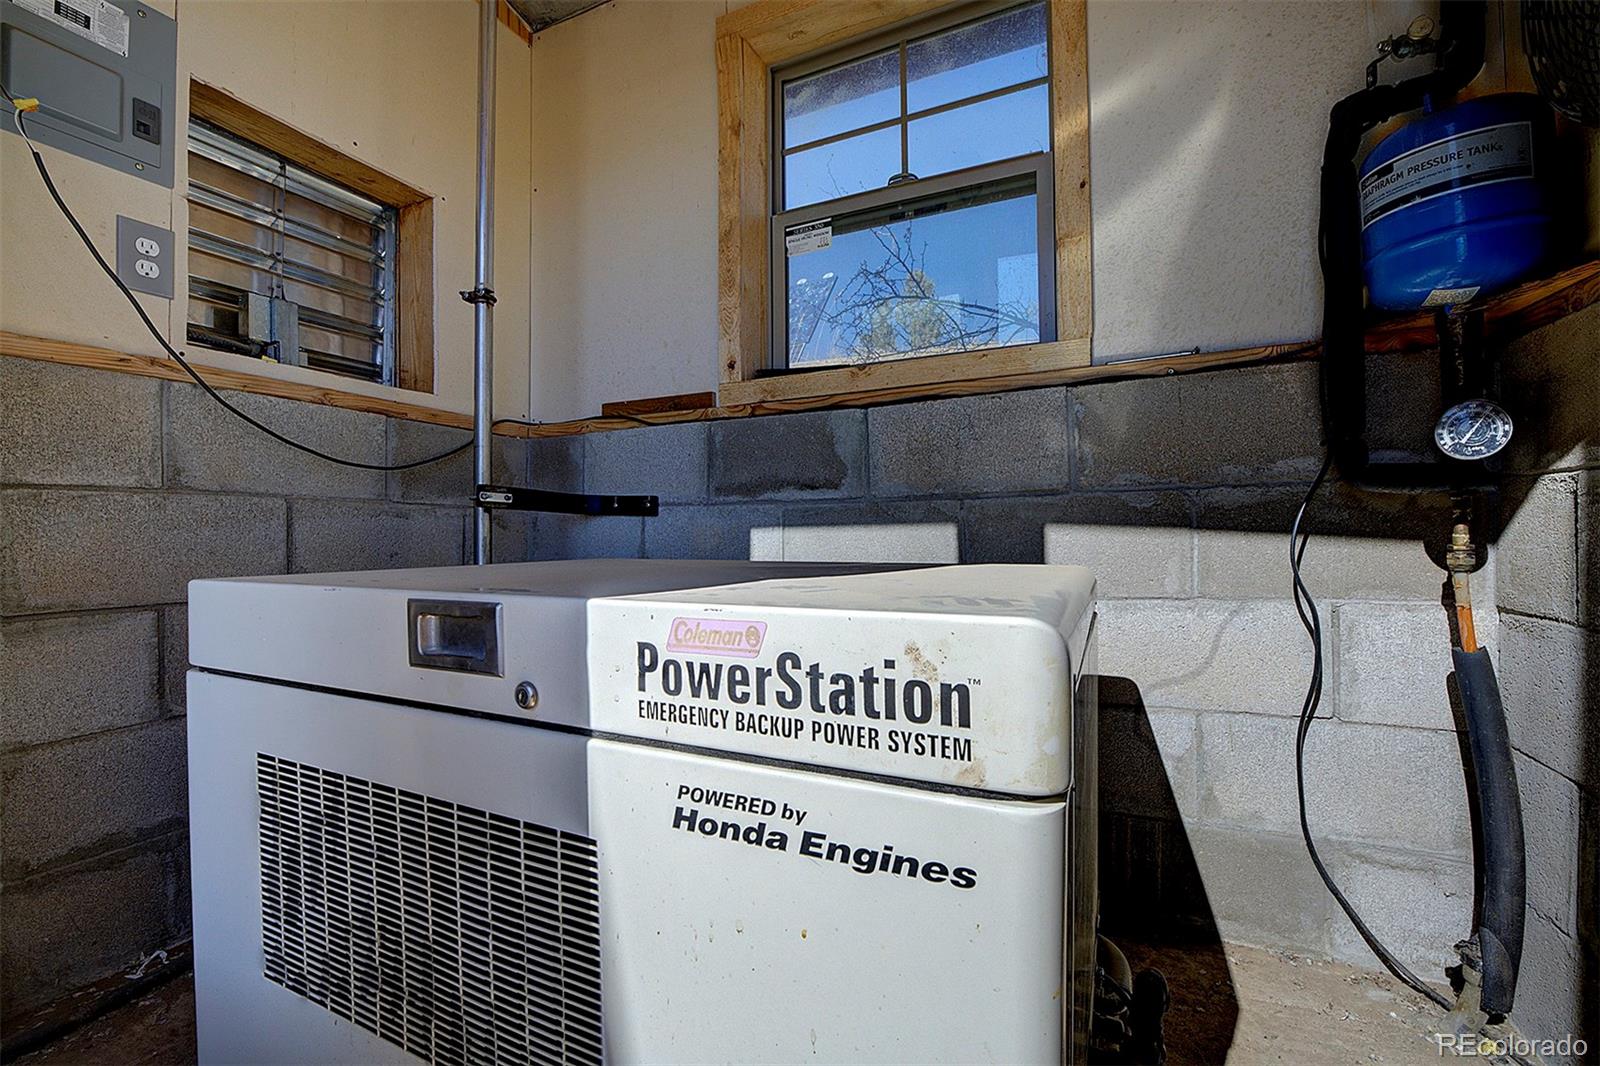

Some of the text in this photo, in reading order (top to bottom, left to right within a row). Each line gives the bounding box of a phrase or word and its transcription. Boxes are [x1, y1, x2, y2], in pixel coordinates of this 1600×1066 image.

[1406, 150, 1464, 177] PRESSURE
[673, 619, 744, 647] Coleman
[637, 641, 972, 729] PowerStation
[638, 700, 973, 762] EMERGENCY BACKUP POWER SYSTEM
[677, 784, 808, 826] POWERED by
[672, 806, 978, 889] Honda Engines
